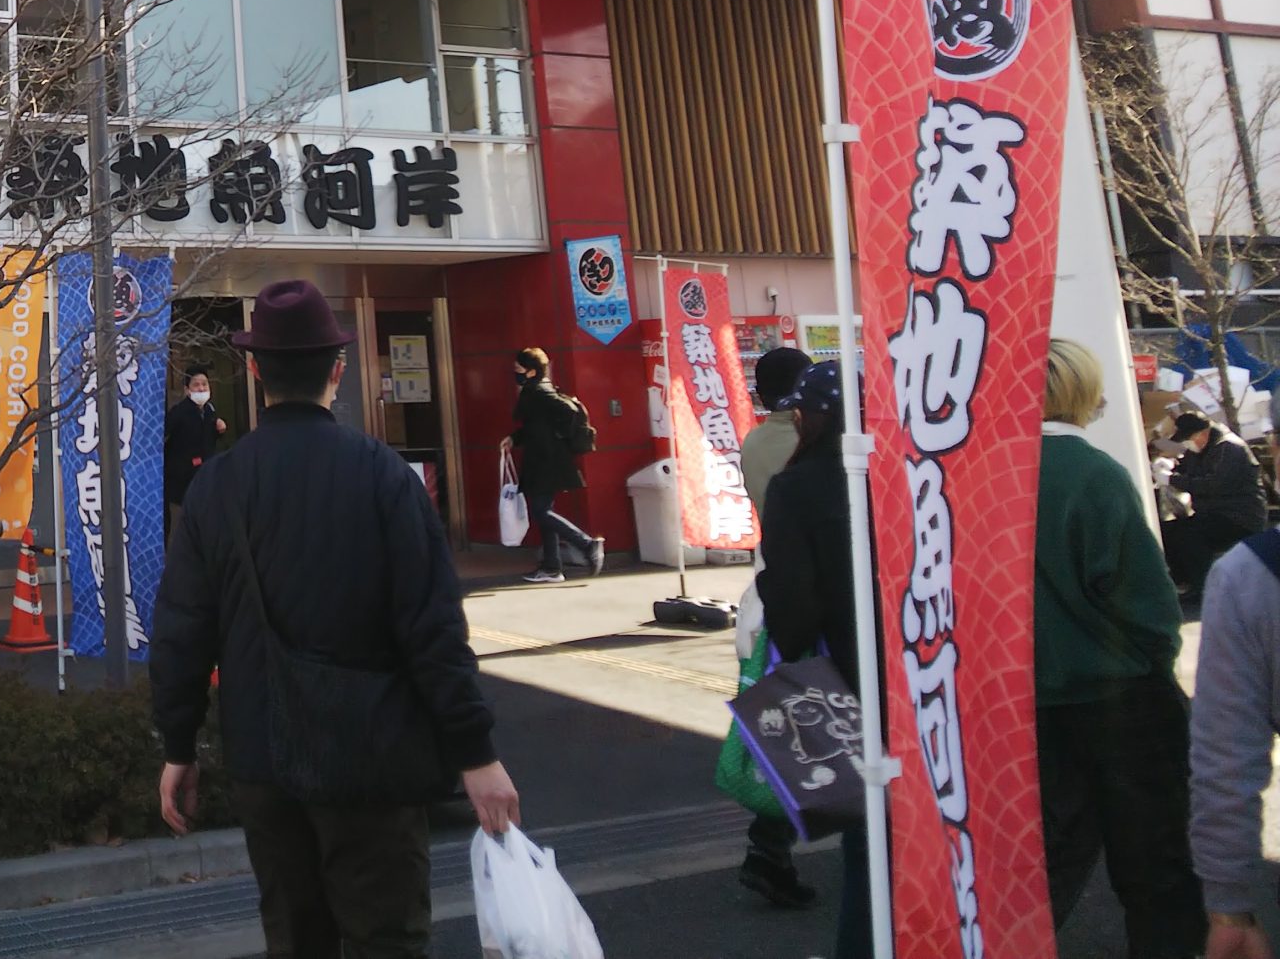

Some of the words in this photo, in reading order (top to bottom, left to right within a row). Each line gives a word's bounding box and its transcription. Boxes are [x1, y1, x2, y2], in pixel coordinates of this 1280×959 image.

[6, 131, 464, 230] 築地魚河岸
[681, 322, 754, 542] 築地魚河岸
